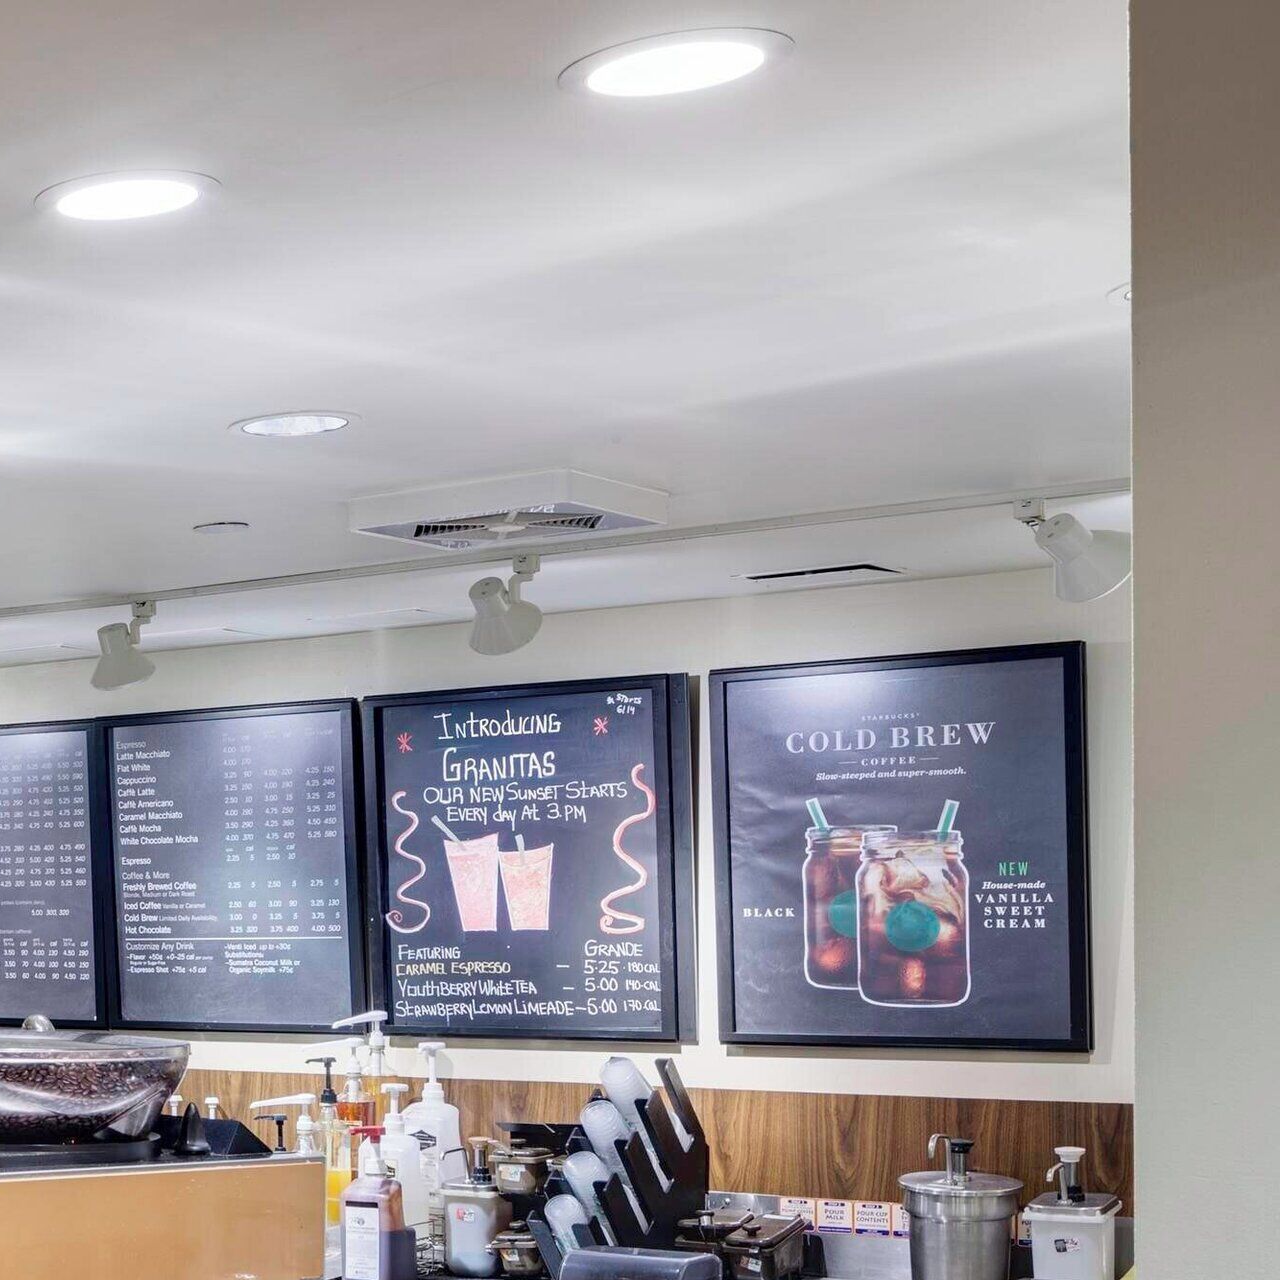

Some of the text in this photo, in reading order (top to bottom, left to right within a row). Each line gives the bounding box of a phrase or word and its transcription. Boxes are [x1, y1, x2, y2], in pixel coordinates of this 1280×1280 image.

[786, 722, 996, 753] COLD BREW
[116, 750, 170, 761] Latte Macchiato
[861, 756, 916, 766] COFFEE
[117, 764, 150, 773] Flat White
[443, 748, 555, 785] GRANITAS
[816, 767, 966, 781] Slow-steeped and super-smooth.
[117, 776, 156, 785] Cappuccino
[138, 788, 155, 796] Latte
[423, 788, 463, 804] OUR
[470, 786, 504, 804] NEW
[138, 799, 173, 808] Americano
[119, 811, 182, 822] Caramel Macchiato
[446, 808, 487, 825] EVERY
[139, 825, 161, 833] Mocha
[120, 835, 198, 846] White Chocolate Mocha
[122, 857, 151, 865] Espresso
[999, 862, 1028, 876] NEW
[123, 883, 146, 891] Freshly
[174, 882, 197, 890] Coffee
[982, 881, 1046, 889] House-made
[975, 893, 1053, 903] VANILLA
[140, 902, 161, 910] Coffee
[984, 906, 1044, 915] SWEET
[743, 907, 795, 918] BLACK
[124, 914, 140, 922] Cold
[984, 919, 1045, 928] CREAM
[125, 926, 171, 934] Hot Chocolate
[585, 940, 643, 957] GRANDE
[396, 964, 447, 976] CARAMEL
[451, 963, 510, 975] ESPRESSO
